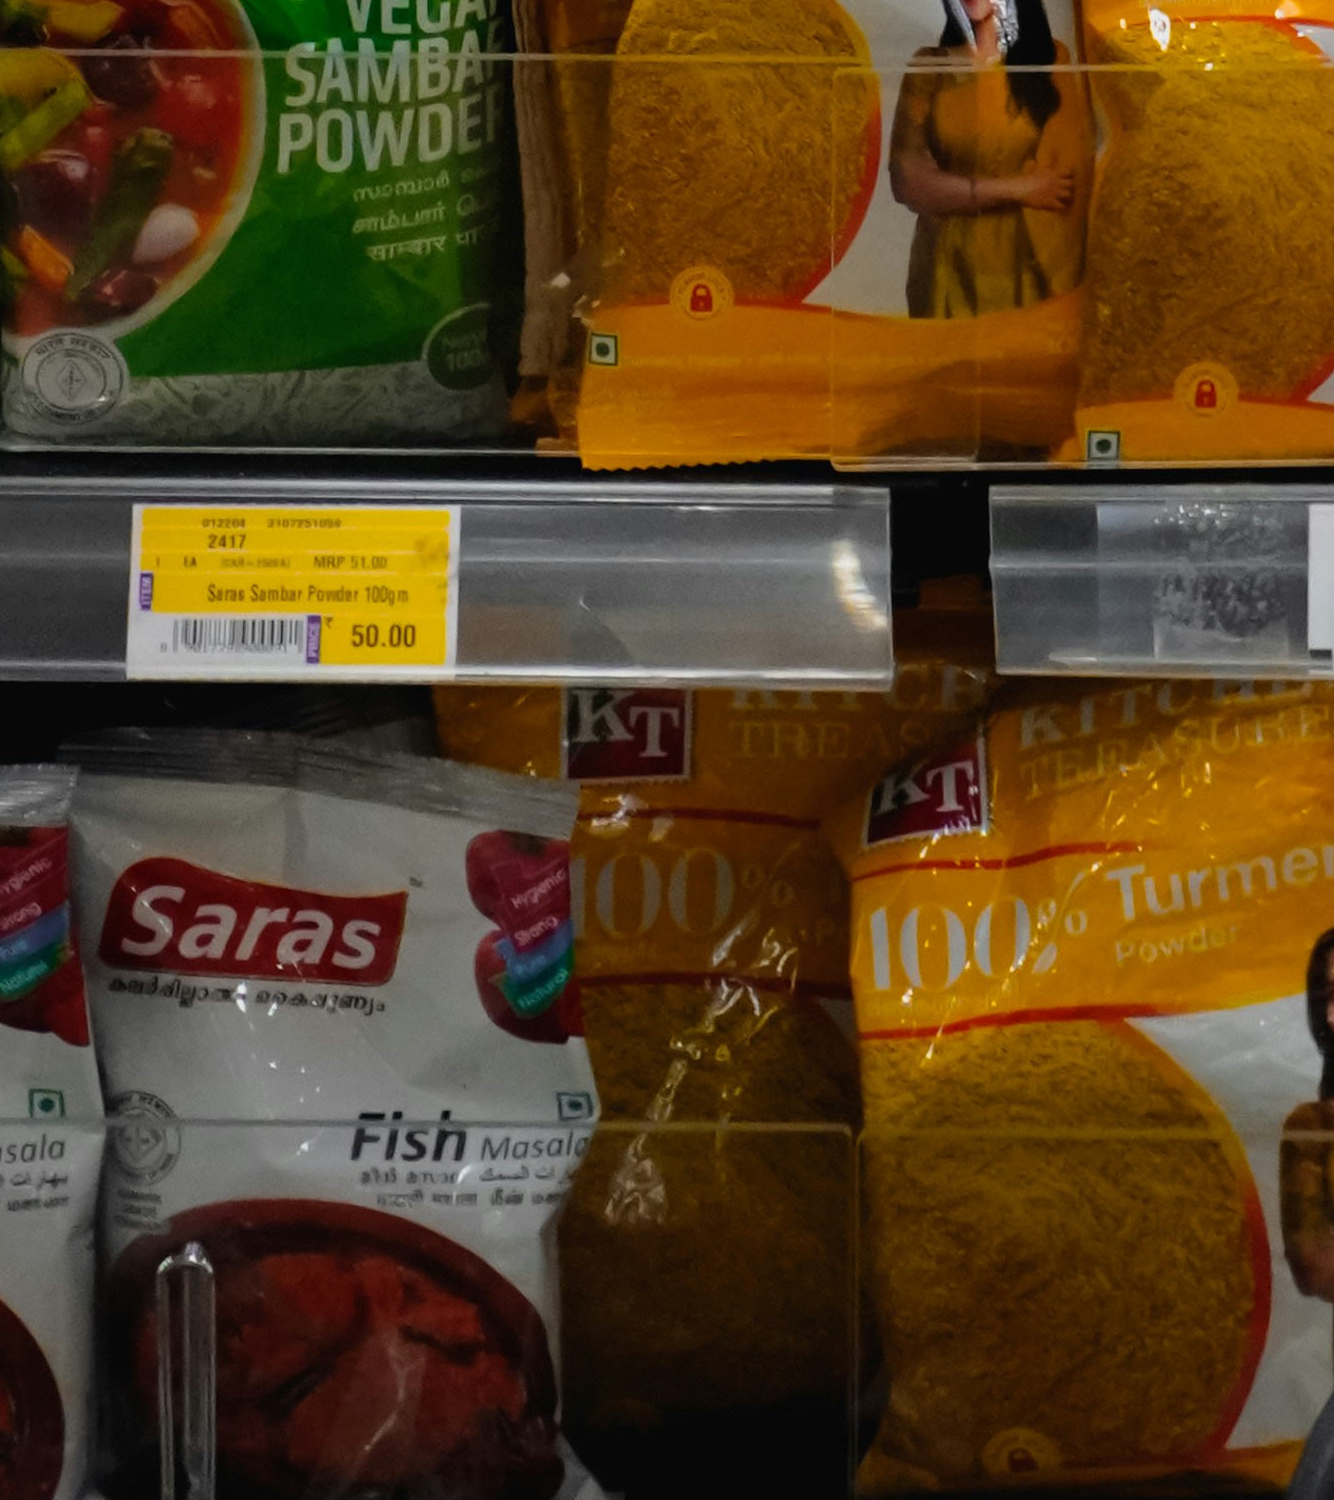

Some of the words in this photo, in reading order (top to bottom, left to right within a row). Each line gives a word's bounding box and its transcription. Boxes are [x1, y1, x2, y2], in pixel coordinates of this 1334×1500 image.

[208, 534, 246, 548] 2417
[208, 585, 244, 601] Saras
[250, 585, 302, 602] Sambar
[307, 587, 357, 602] Powder
[366, 587, 409, 605] 100gm
[352, 624, 416, 647] 50.00
[120, 885, 382, 972] Saras
